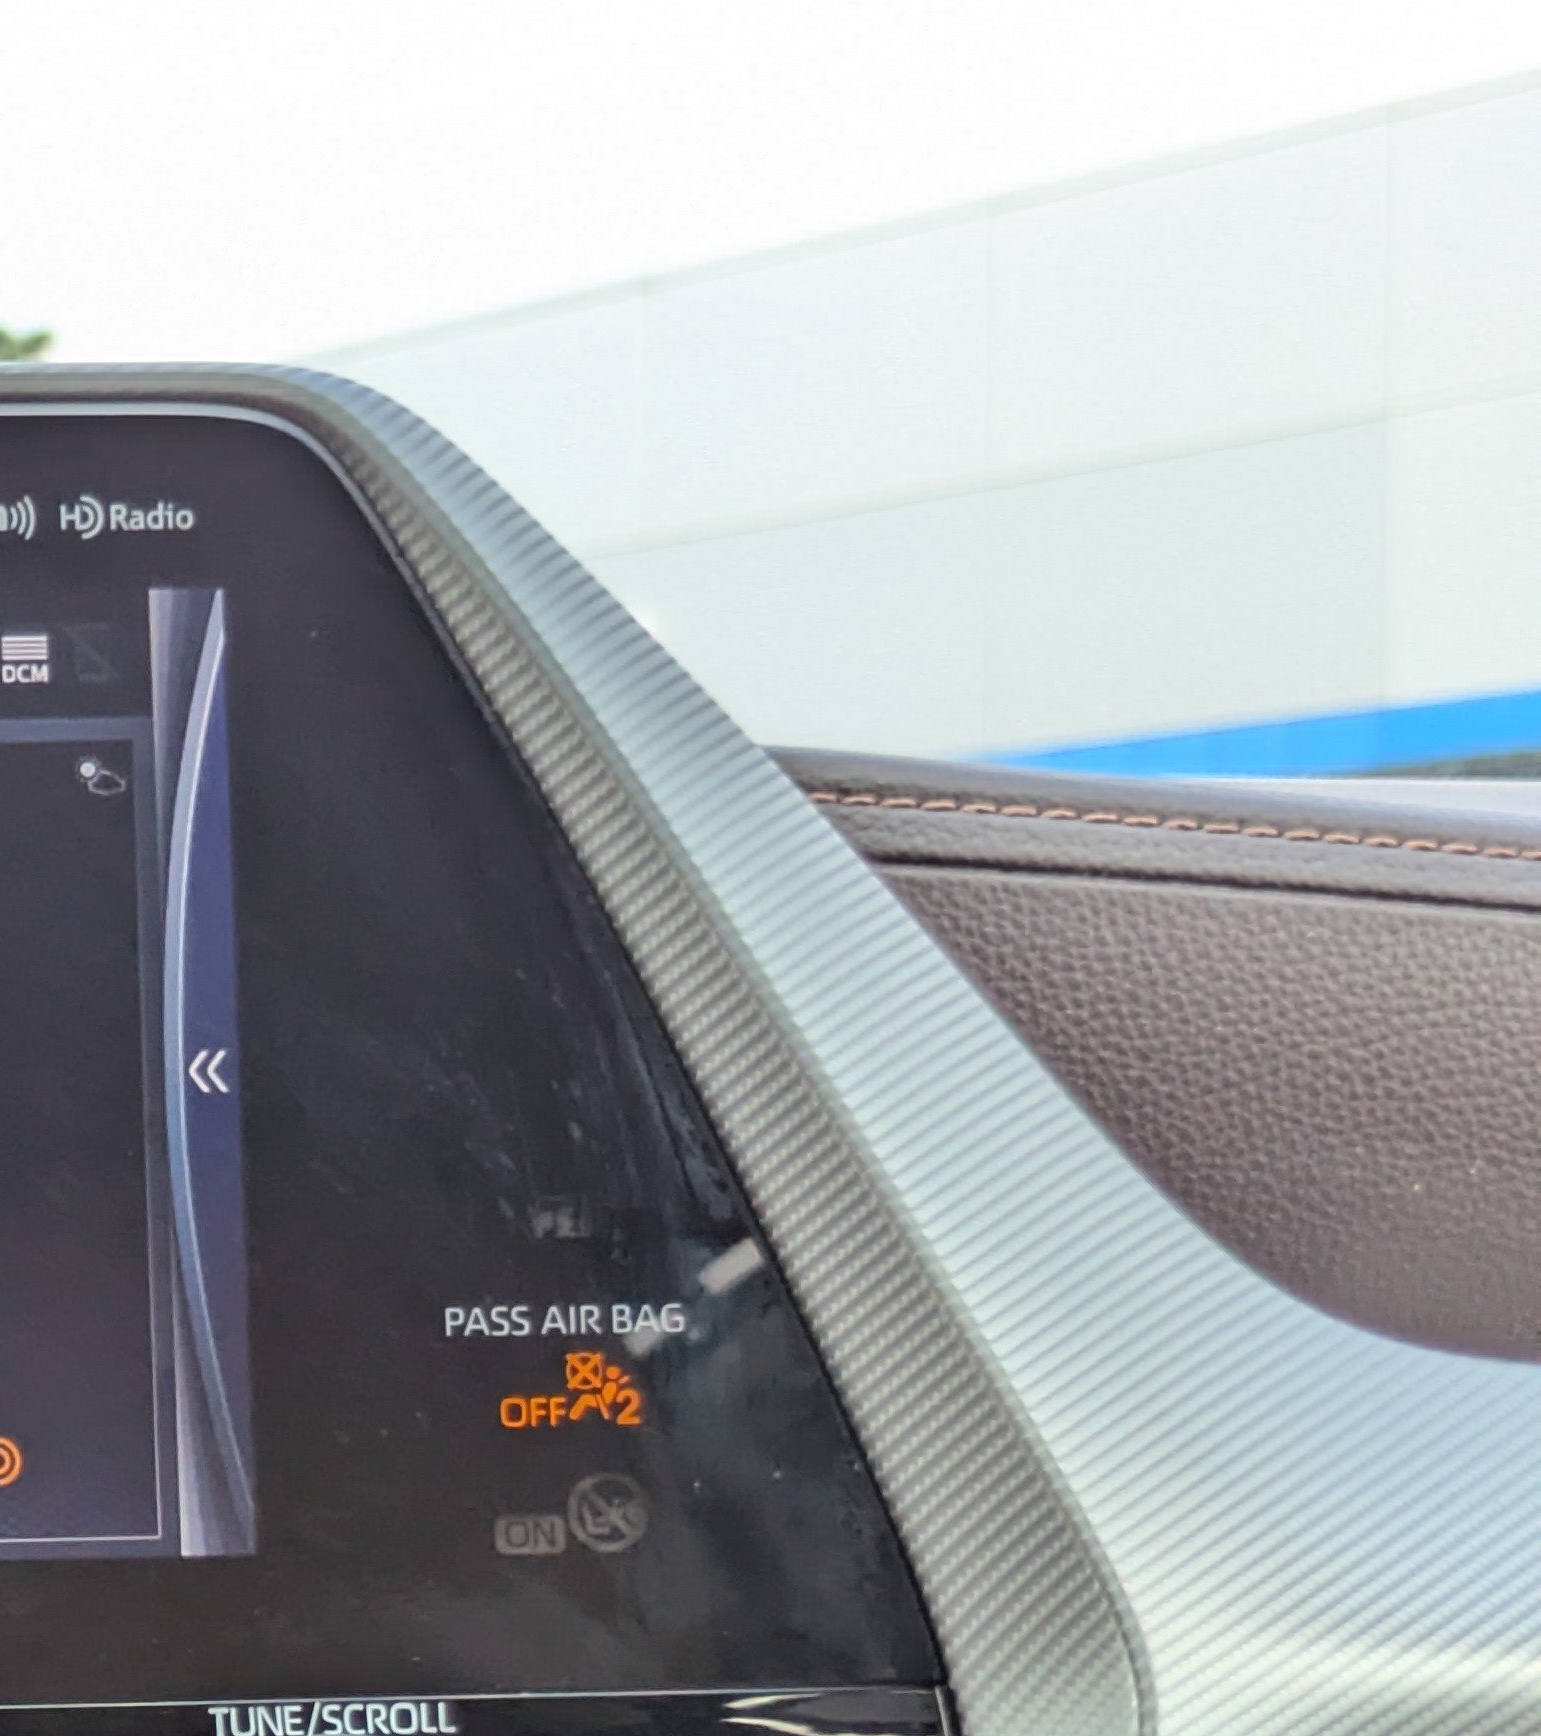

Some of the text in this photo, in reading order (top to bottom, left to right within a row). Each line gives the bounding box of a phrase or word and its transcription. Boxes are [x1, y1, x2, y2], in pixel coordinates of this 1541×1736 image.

[110, 502, 195, 531] Radio
[2, 664, 49, 683] DCM
[445, 1304, 685, 1336] PASS AIR BAG
[500, 1397, 566, 1428] OFF
[505, 1522, 557, 1546] ON
